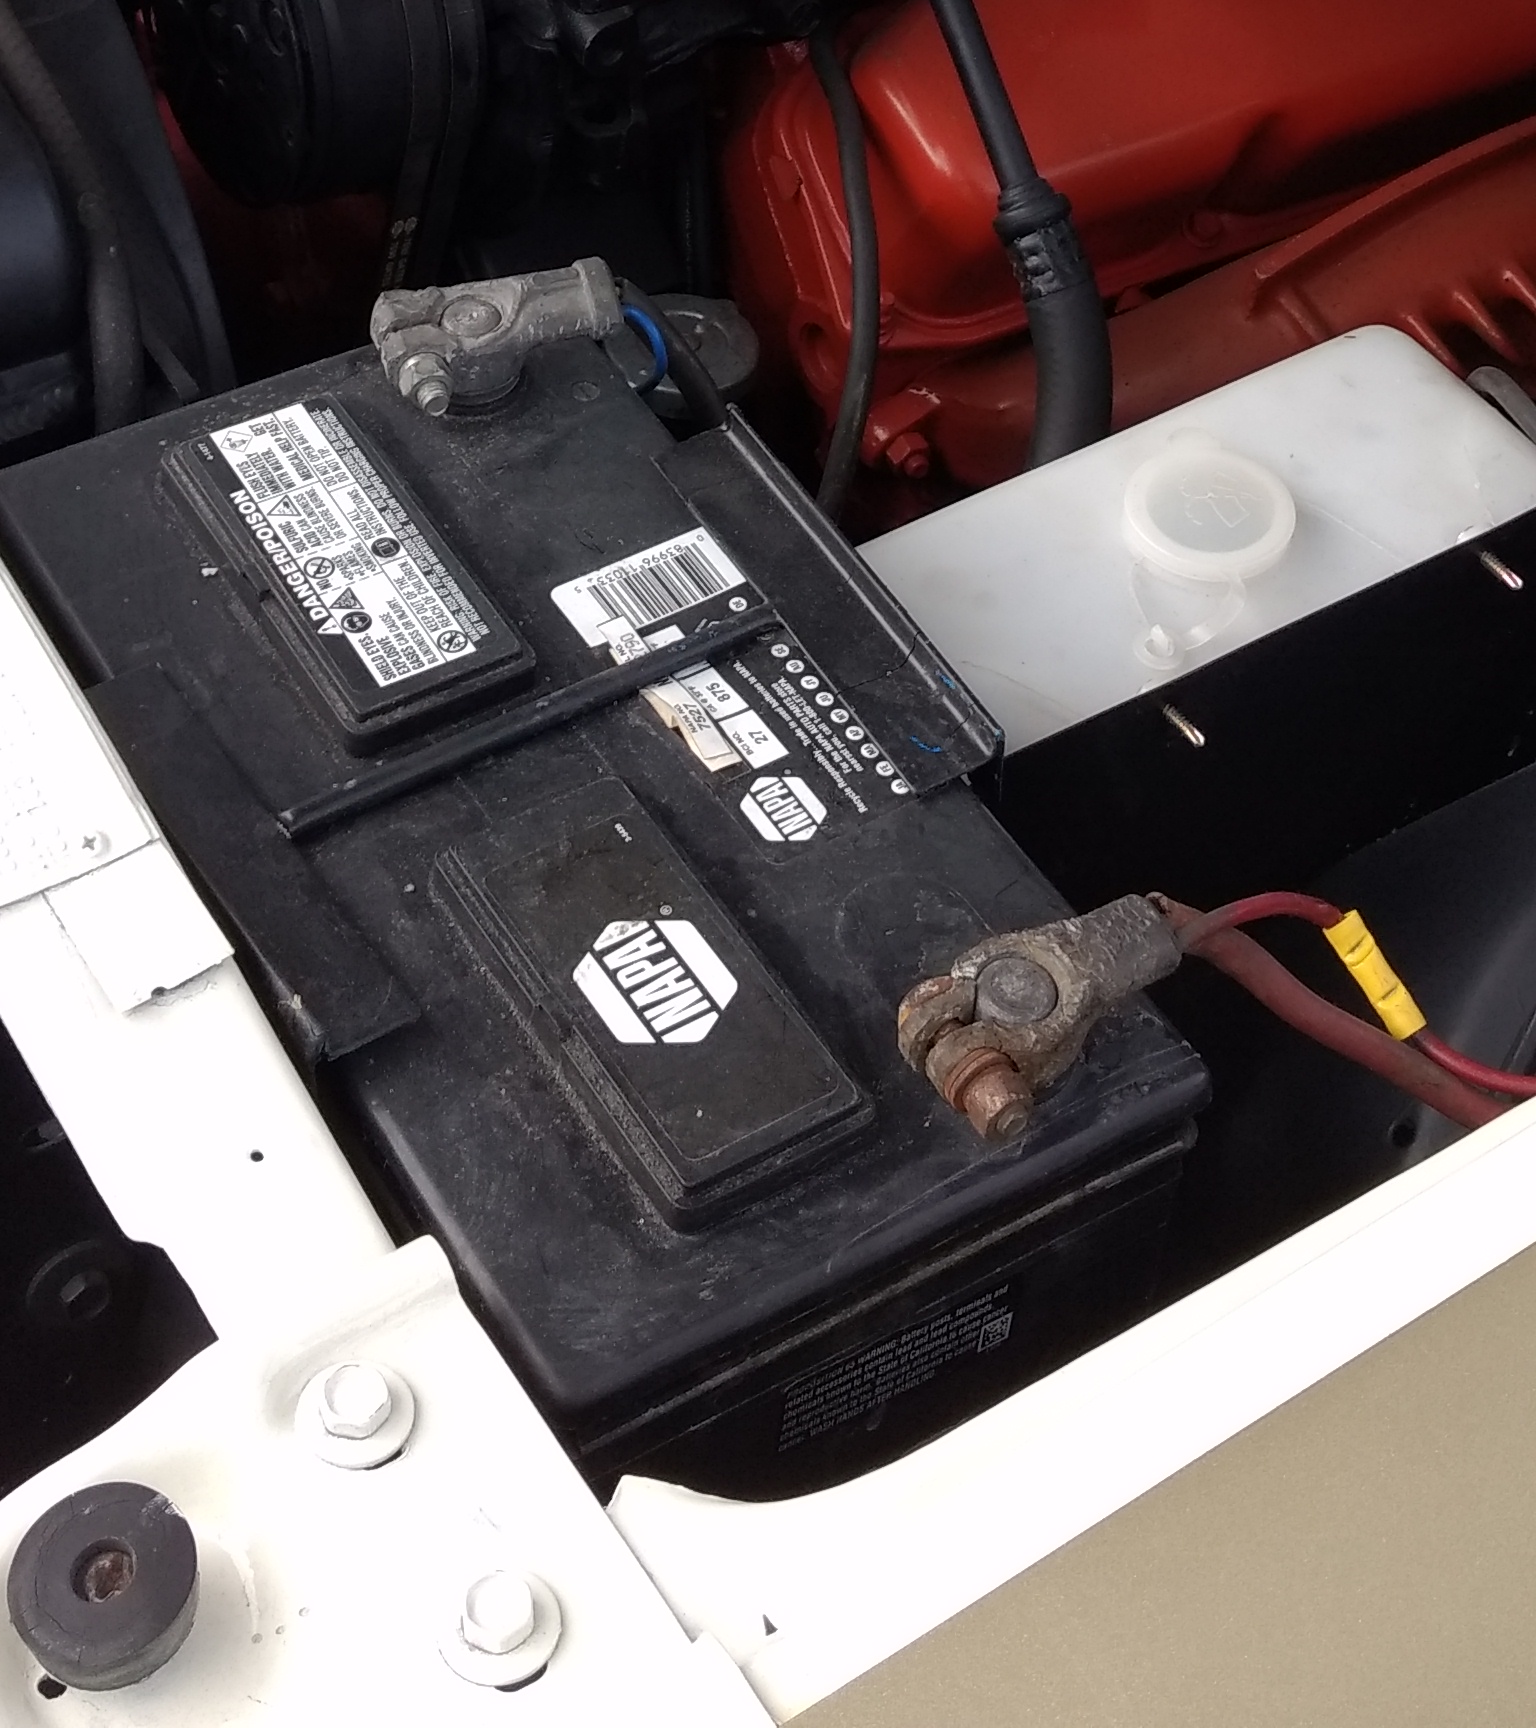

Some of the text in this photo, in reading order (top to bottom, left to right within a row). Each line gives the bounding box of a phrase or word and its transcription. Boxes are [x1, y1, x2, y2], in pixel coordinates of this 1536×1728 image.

[247, 421, 267, 437] GET
[261, 417, 314, 481] MEDICAL HELP FAST.
[282, 418, 338, 487] DO NOT OPEN BATTERY.
[316, 445, 350, 483] DO NOT TIP.
[235, 459, 270, 500] FLUSH EYES
[245, 451, 283, 495] IMMEDIATELY
[260, 446, 296, 491] WITH WATER.
[292, 492, 335, 544] CAUSE BLINDNESS
[303, 486, 347, 540] OR SEVERE BURNS.
[346, 487, 387, 536] INSTRUCTIONS.
[346, 507, 375, 541] READ ALL
[277, 520, 309, 554] SULFURIC
[295, 517, 323, 548] ACID CAN
[230, 489, 327, 620] DANGER/POISON
[572, 533, 705, 594] 0 83996 11033 5
[315, 577, 332, 591] NO
[397, 559, 453, 628] REACH OF CHILDREN.
[392, 574, 441, 633] KEEP OUT OF THE
[378, 611, 425, 670] GASES CAN CAUSE
[385, 596, 439, 665] BLINDNESS OR INJURY.
[357, 632, 397, 681] SHIELD EYES.
[375, 635, 411, 676] EXPLOSIVE
[788, 661, 802, 671] AU
[704, 681, 733, 703] 875
[704, 702, 718, 713] CA
[782, 696, 805, 718] PARTS
[817, 693, 831, 703] JU
[680, 714, 698, 733] NAPA
[682, 700, 711, 731] 7527
[799, 715, 819, 734] AUTO
[833, 710, 847, 721] MY
[729, 730, 755, 755] BCI NO.
[746, 728, 769, 744] 27
[814, 732, 834, 752] NAPA
[847, 727, 861, 737] AP
[829, 749, 843, 763] the
[862, 744, 877, 756] MA
[838, 760, 852, 774] For
[878, 763, 892, 773] FE
[751, 781, 812, 834] NAPA
[843, 786, 868, 813] Recycle
[597, 931, 713, 1030] NAPA
